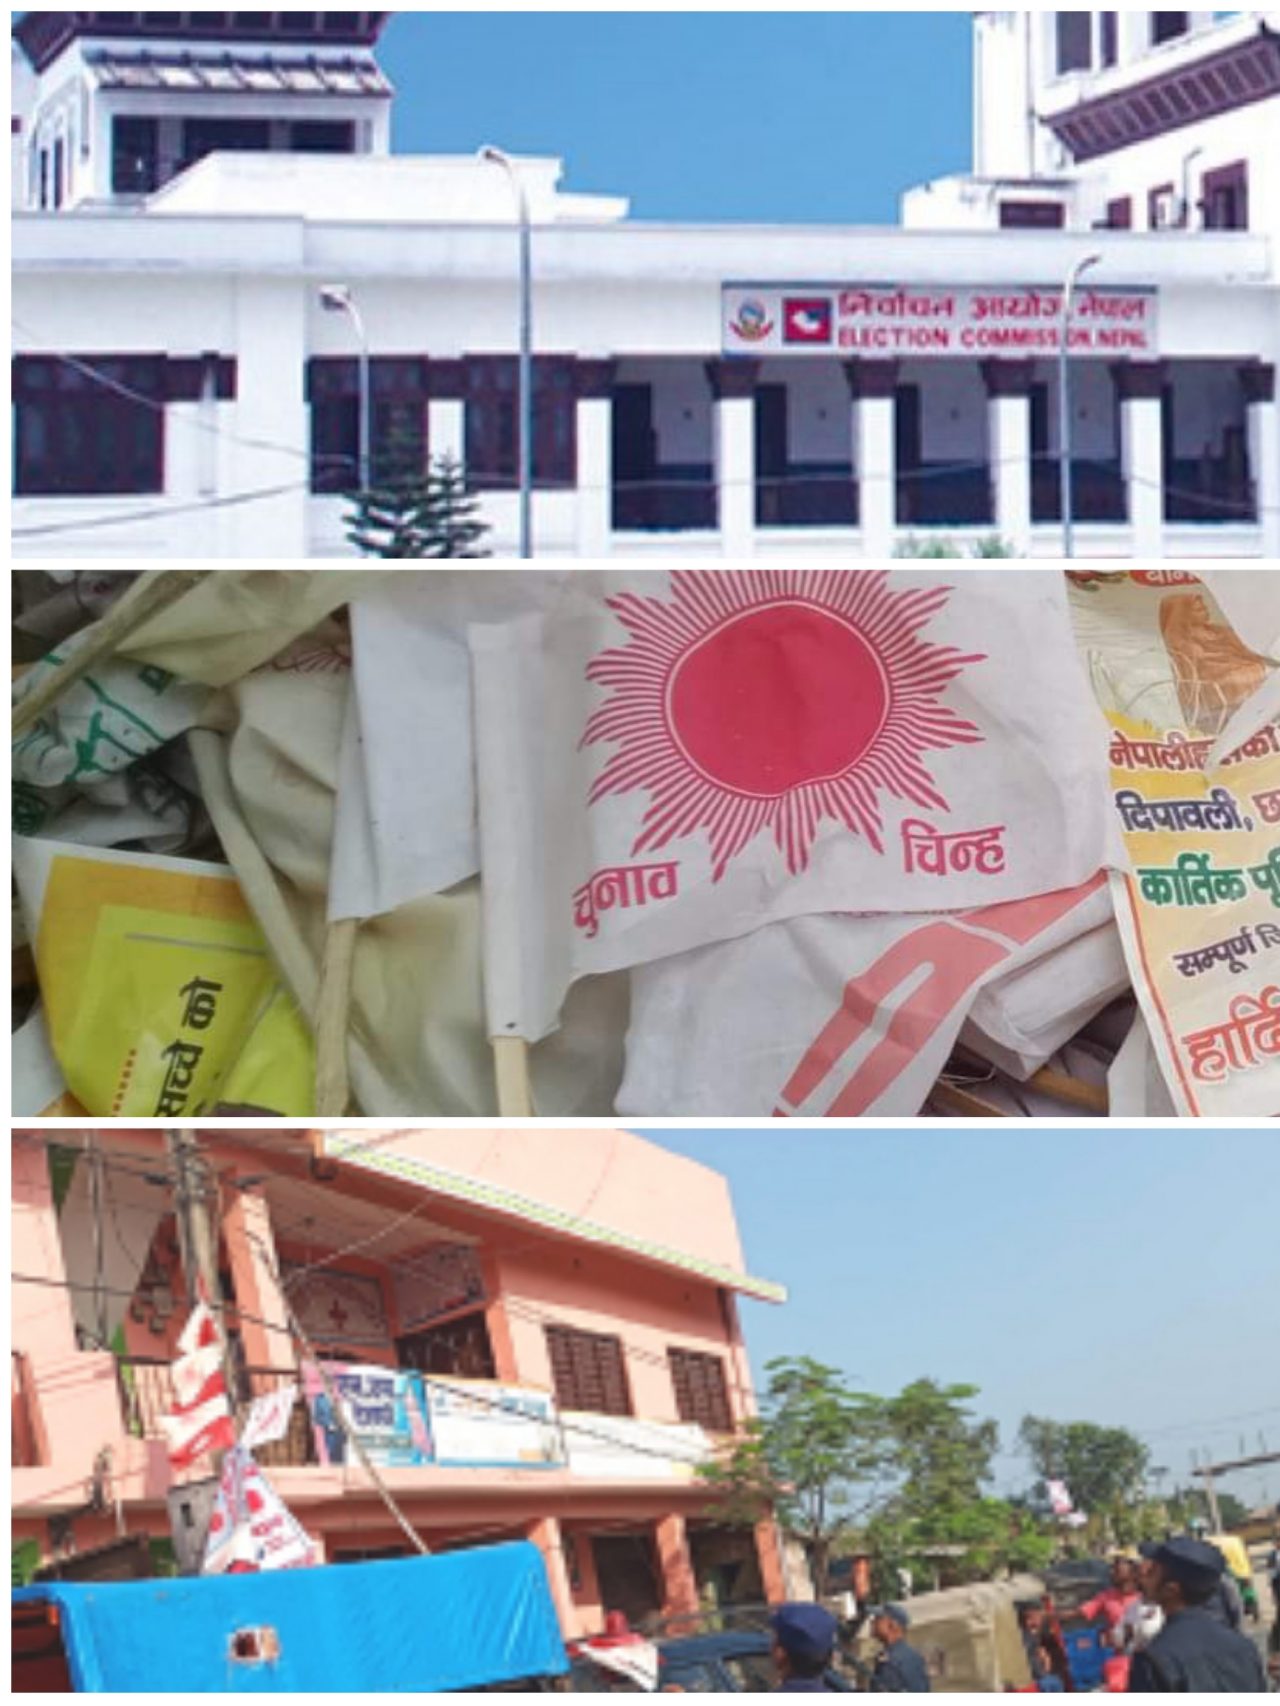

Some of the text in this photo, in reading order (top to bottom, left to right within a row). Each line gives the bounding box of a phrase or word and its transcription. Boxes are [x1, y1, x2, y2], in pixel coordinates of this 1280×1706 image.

[838, 327, 949, 348] ELECTION
[572, 817, 1006, 939] चुनाव चिन्ह
[1138, 852, 1247, 907] कार्तिक
[1173, 926, 1257, 978] सम्पूर्ण
[178, 976, 223, 1031] को
